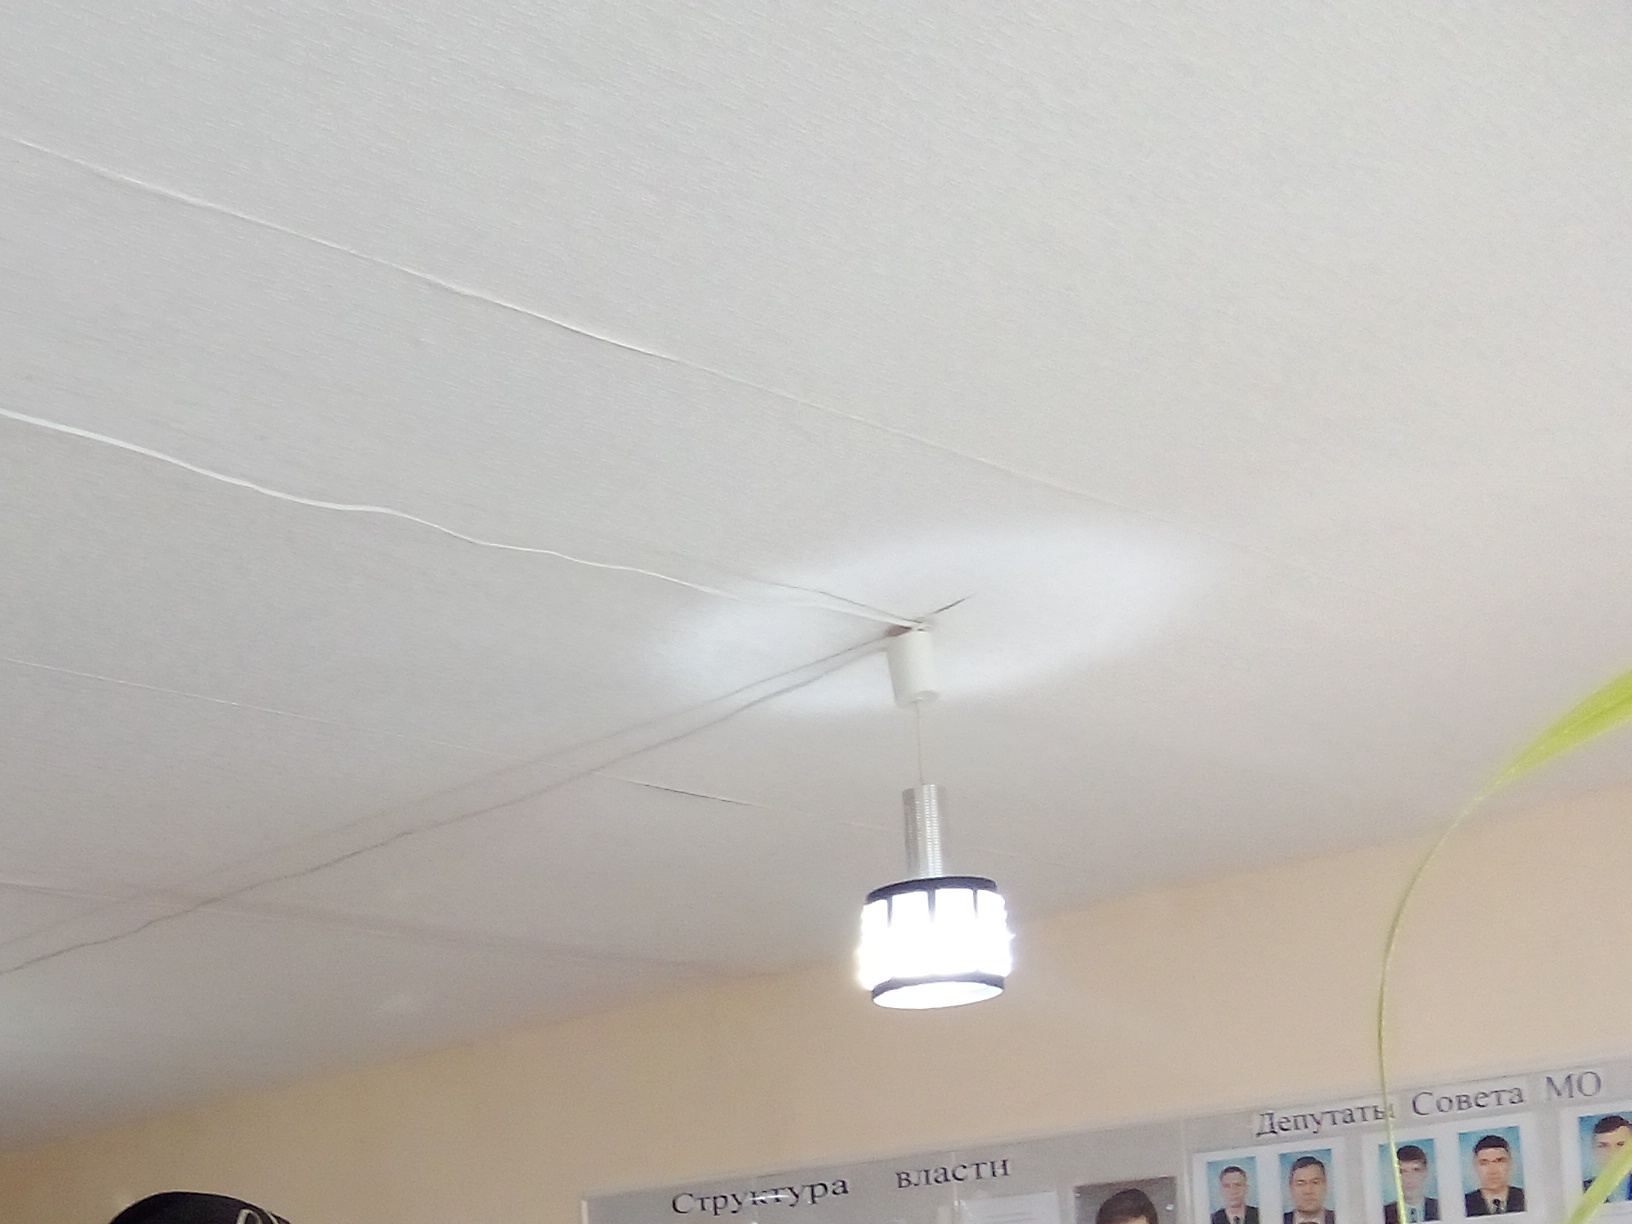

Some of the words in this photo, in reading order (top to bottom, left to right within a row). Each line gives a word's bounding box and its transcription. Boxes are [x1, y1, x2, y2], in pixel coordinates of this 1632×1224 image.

[1256, 1100, 1395, 1138] Депутаты
[1411, 1085, 1525, 1117] Совета
[1545, 1070, 1603, 1099] МО
[670, 1178, 850, 1217] Структура
[894, 1158, 1012, 1189] власти
